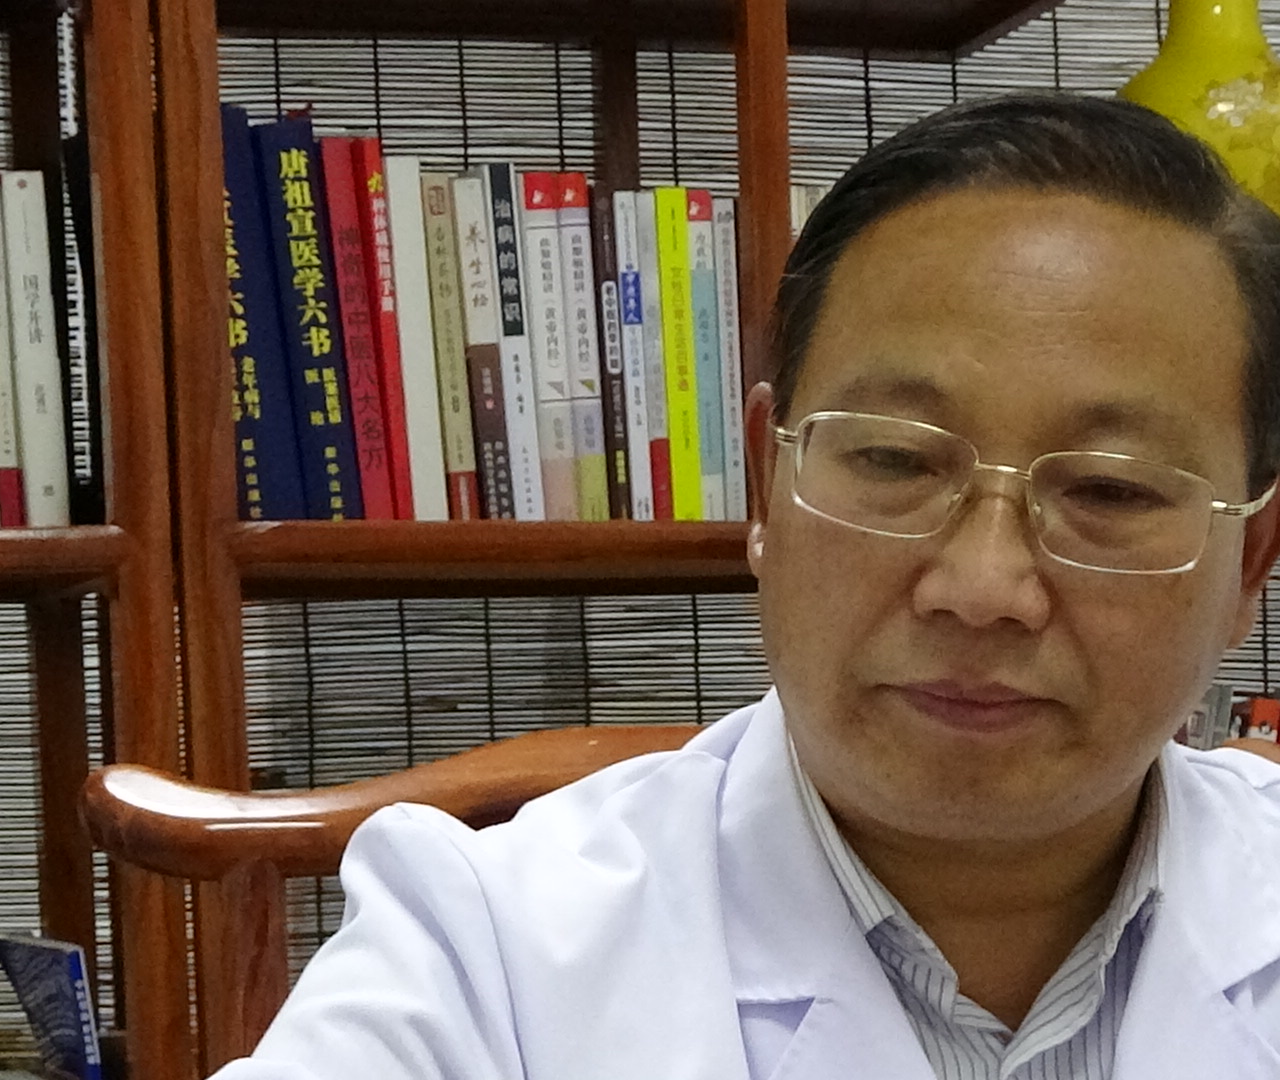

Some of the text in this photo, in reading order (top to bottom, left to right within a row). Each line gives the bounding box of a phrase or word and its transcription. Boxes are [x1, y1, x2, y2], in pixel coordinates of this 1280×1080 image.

[279, 148, 331, 357] 唐祖宣医学六书
